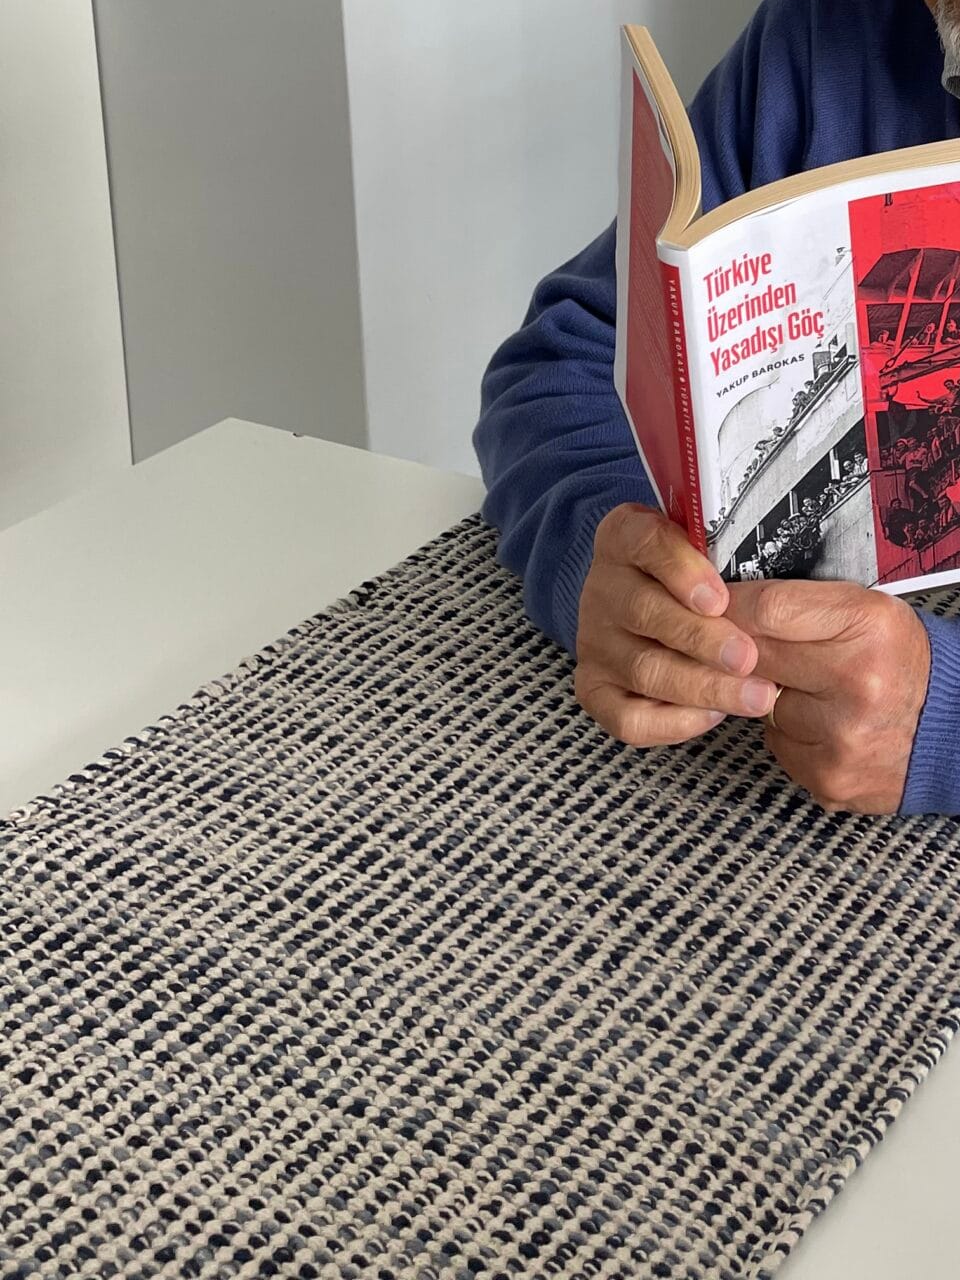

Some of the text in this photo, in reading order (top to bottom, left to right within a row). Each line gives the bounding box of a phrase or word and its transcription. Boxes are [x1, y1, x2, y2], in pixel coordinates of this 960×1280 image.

[703, 253, 772, 303] Türkiye
[668, 279, 678, 316] YAKUP
[673, 321, 685, 373] BAROKAS
[707, 282, 796, 343] Üzerinden
[710, 308, 825, 377] Yasadışı Göç
[716, 353, 805, 398] YAKUP BAROKAS
